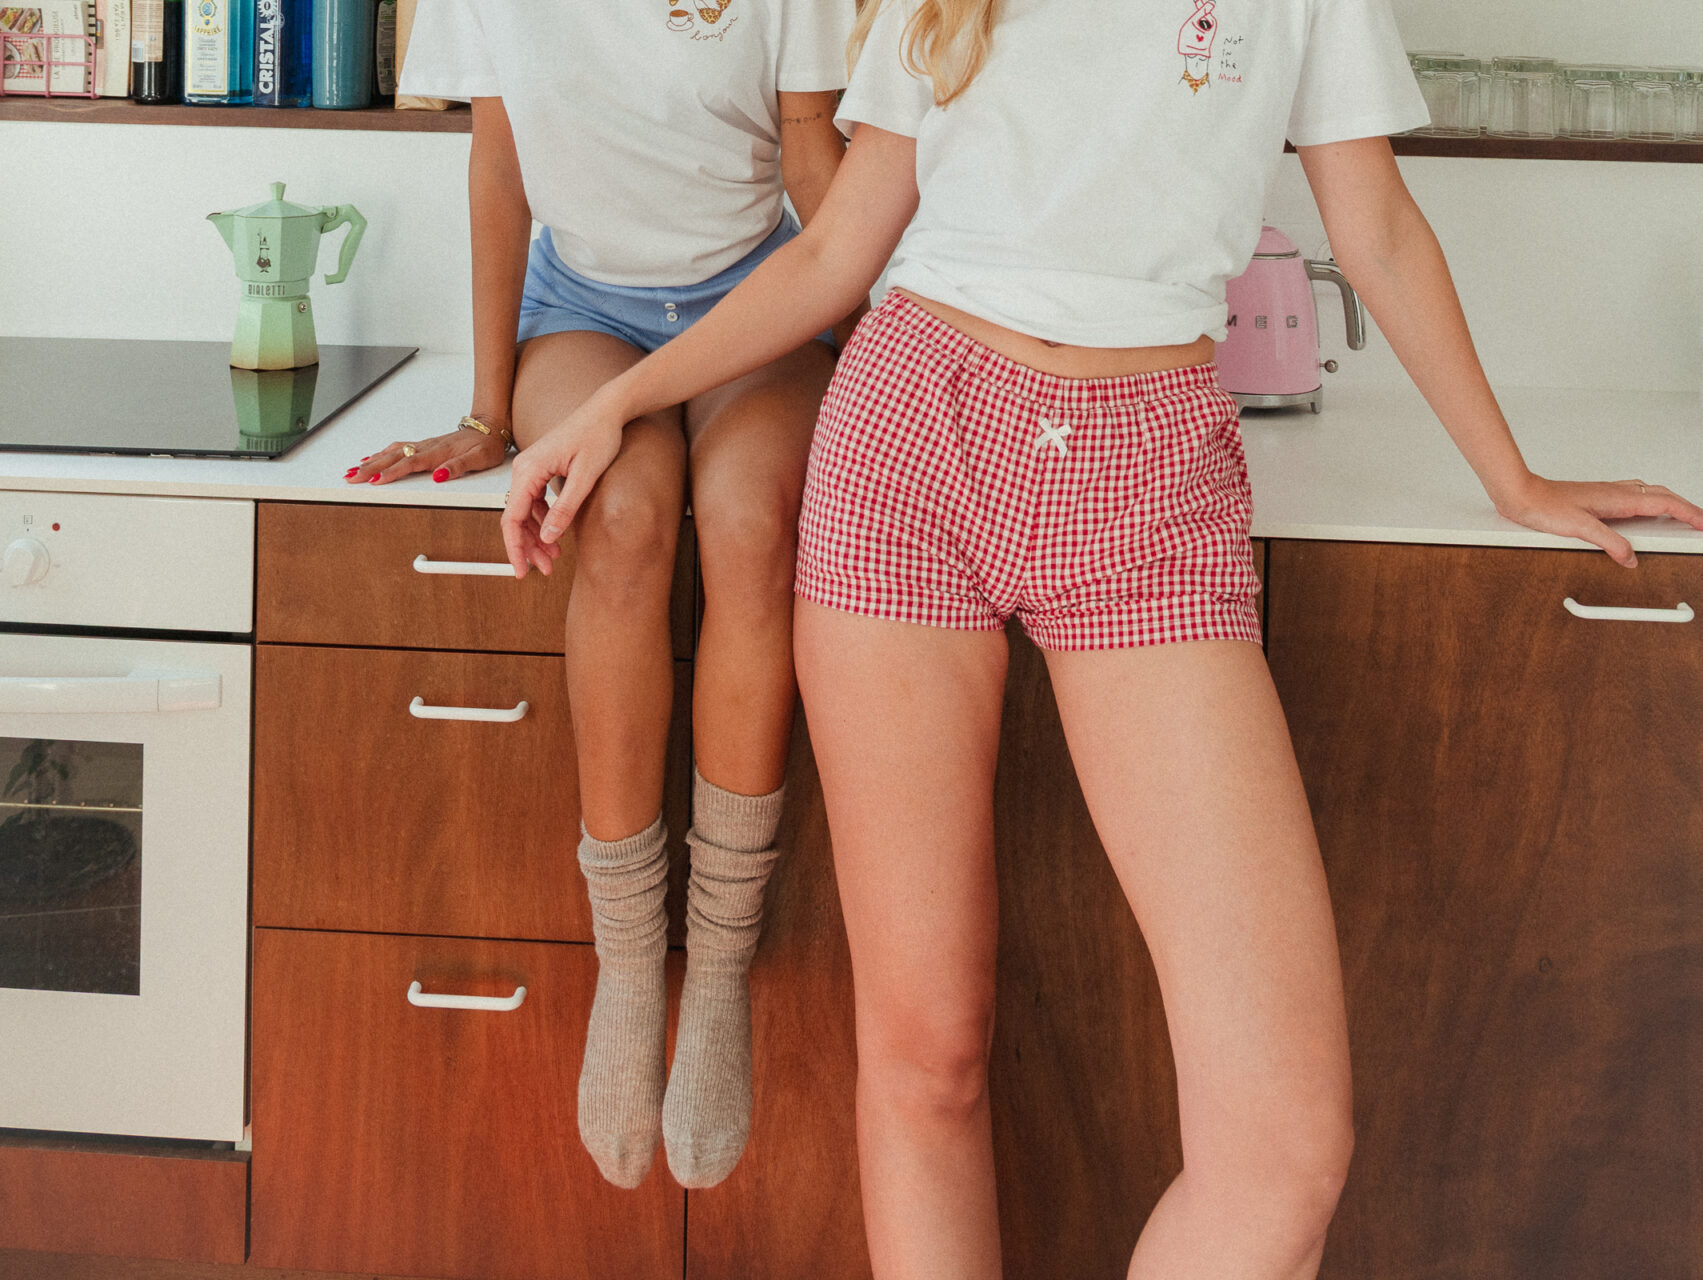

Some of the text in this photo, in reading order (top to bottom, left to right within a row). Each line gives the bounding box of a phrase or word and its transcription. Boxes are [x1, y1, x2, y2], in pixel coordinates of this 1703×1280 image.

[258, 21, 275, 95] CRISTAL
[1222, 48, 1232, 57] in
[1220, 59, 1237, 69] the
[1227, 314, 1299, 329] MEG
